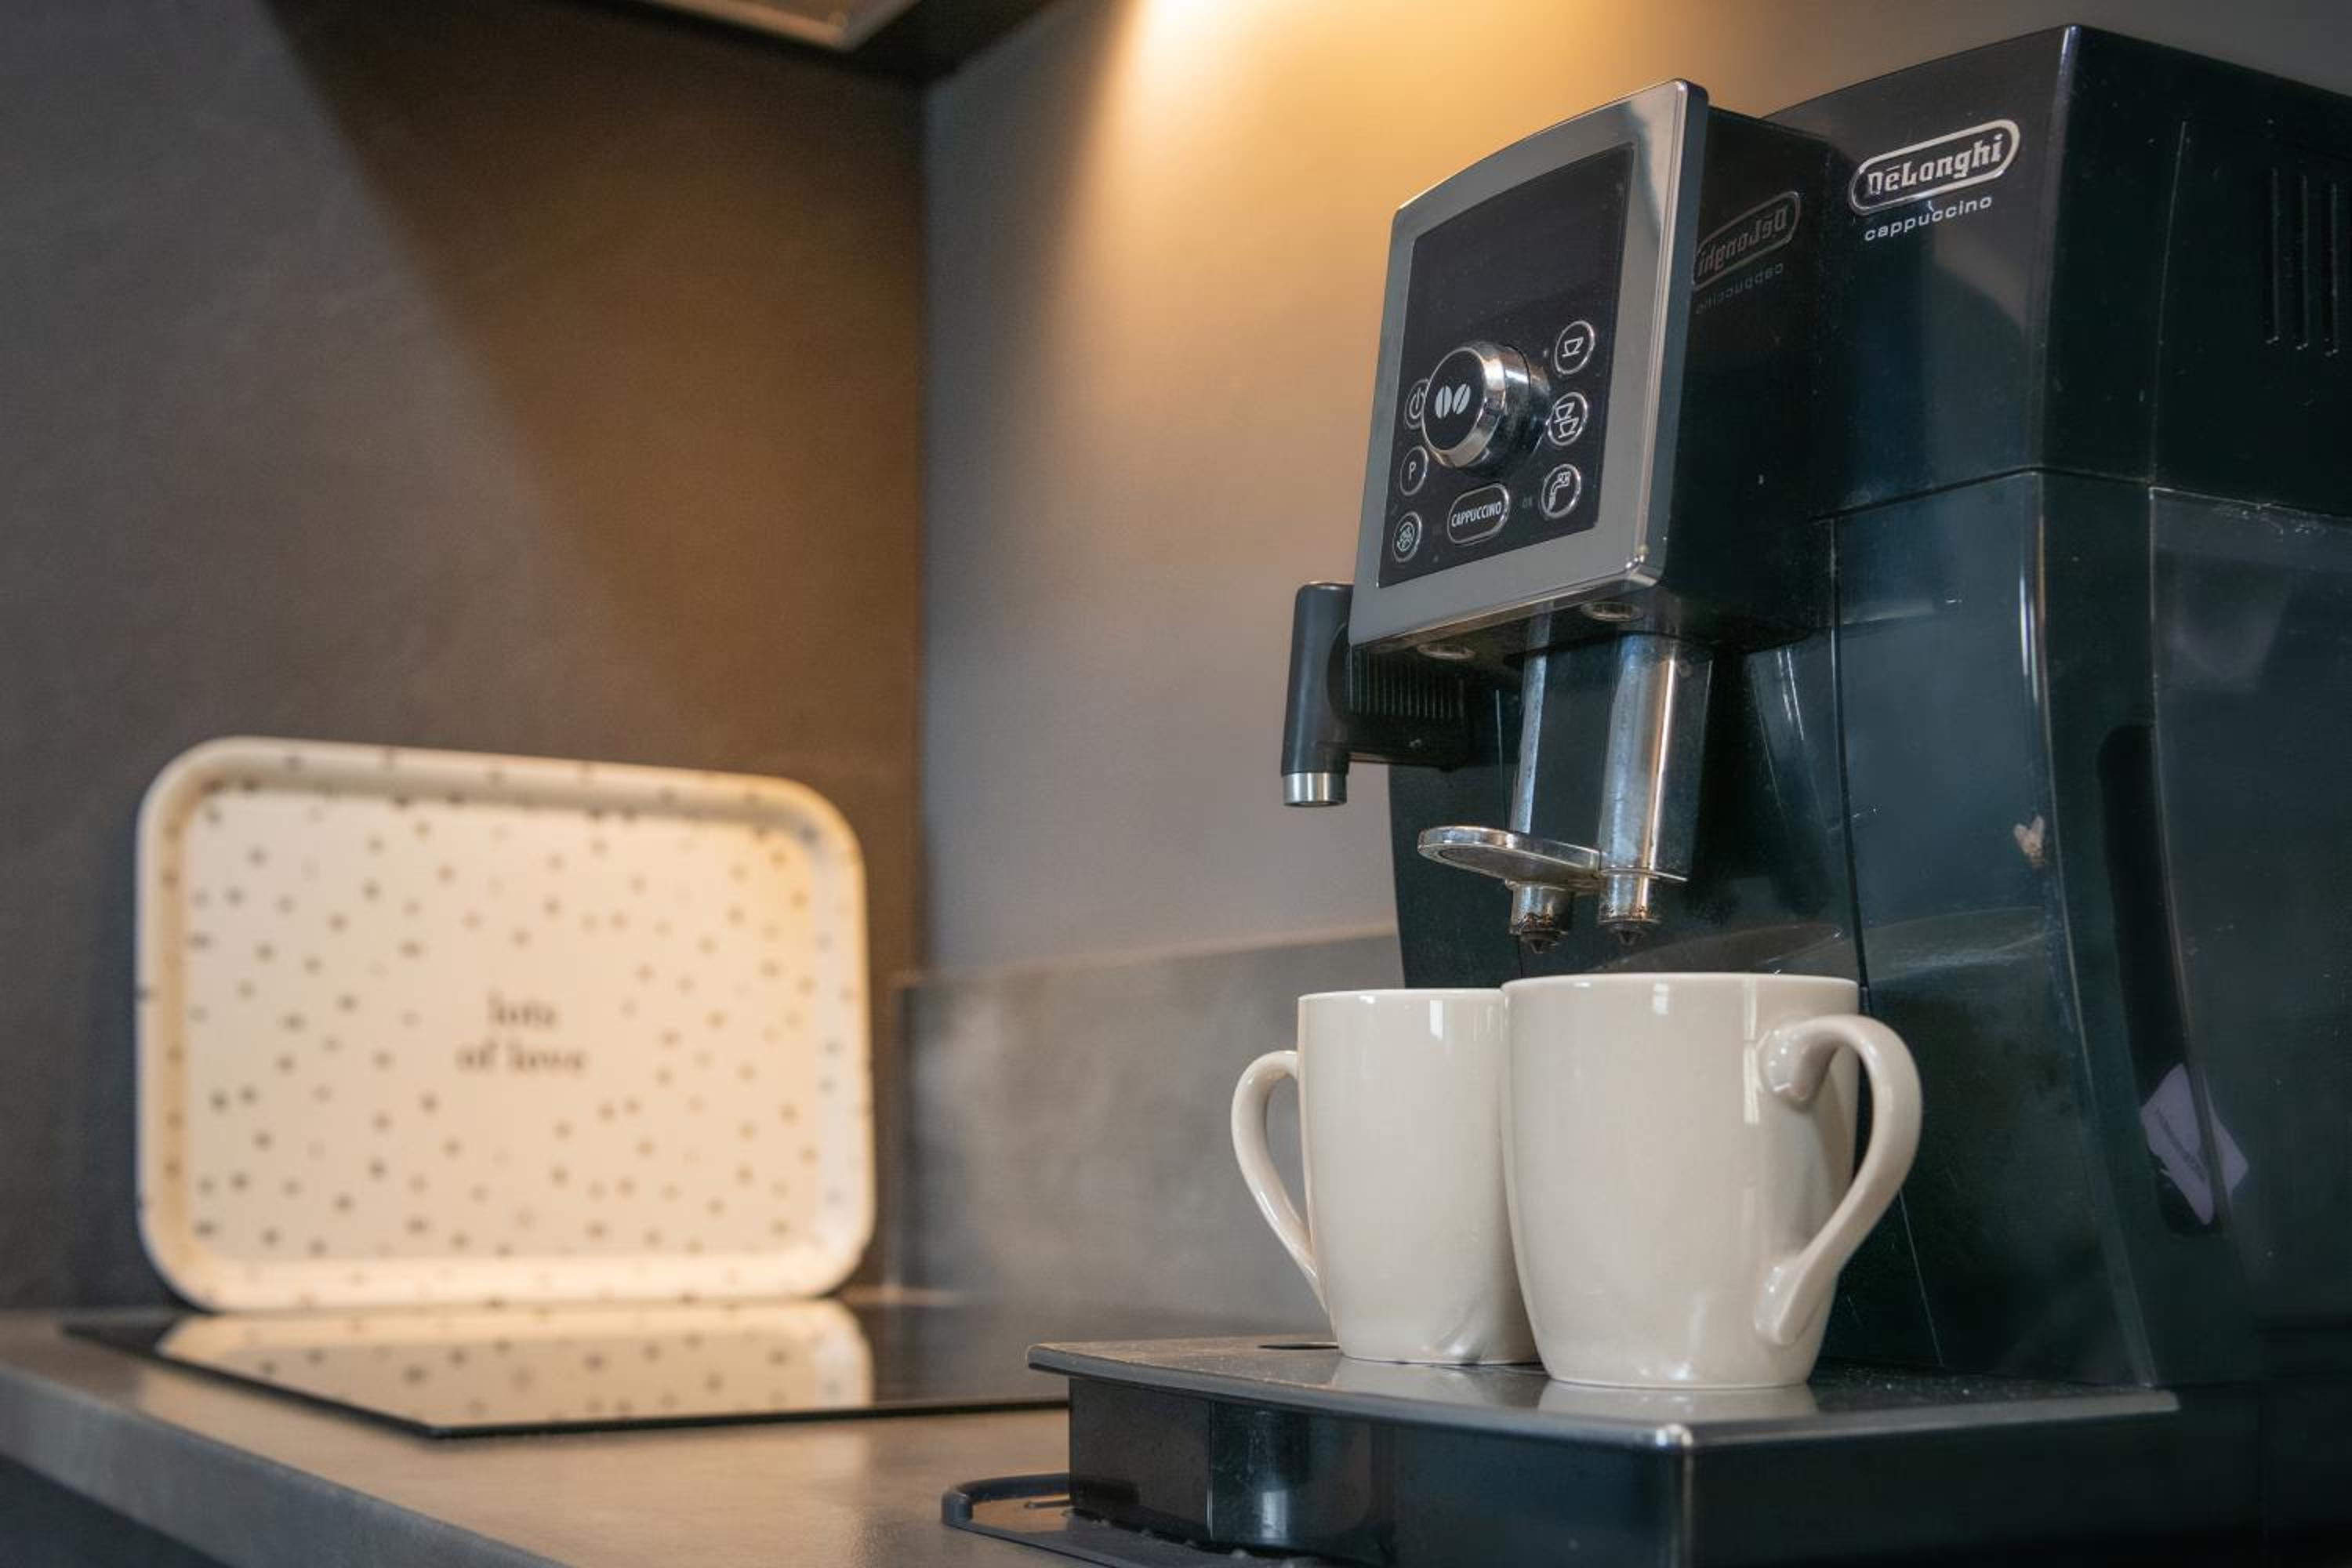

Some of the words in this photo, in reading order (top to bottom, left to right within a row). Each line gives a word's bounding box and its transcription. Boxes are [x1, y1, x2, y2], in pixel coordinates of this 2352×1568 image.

[1864, 196, 1993, 241] cappuccino
[1408, 461, 1417, 481] P
[1451, 501, 1502, 528] CAPPUCCINO
[488, 989, 557, 1029] lots
[456, 1036, 498, 1072] of
[506, 1036, 586, 1073] love
